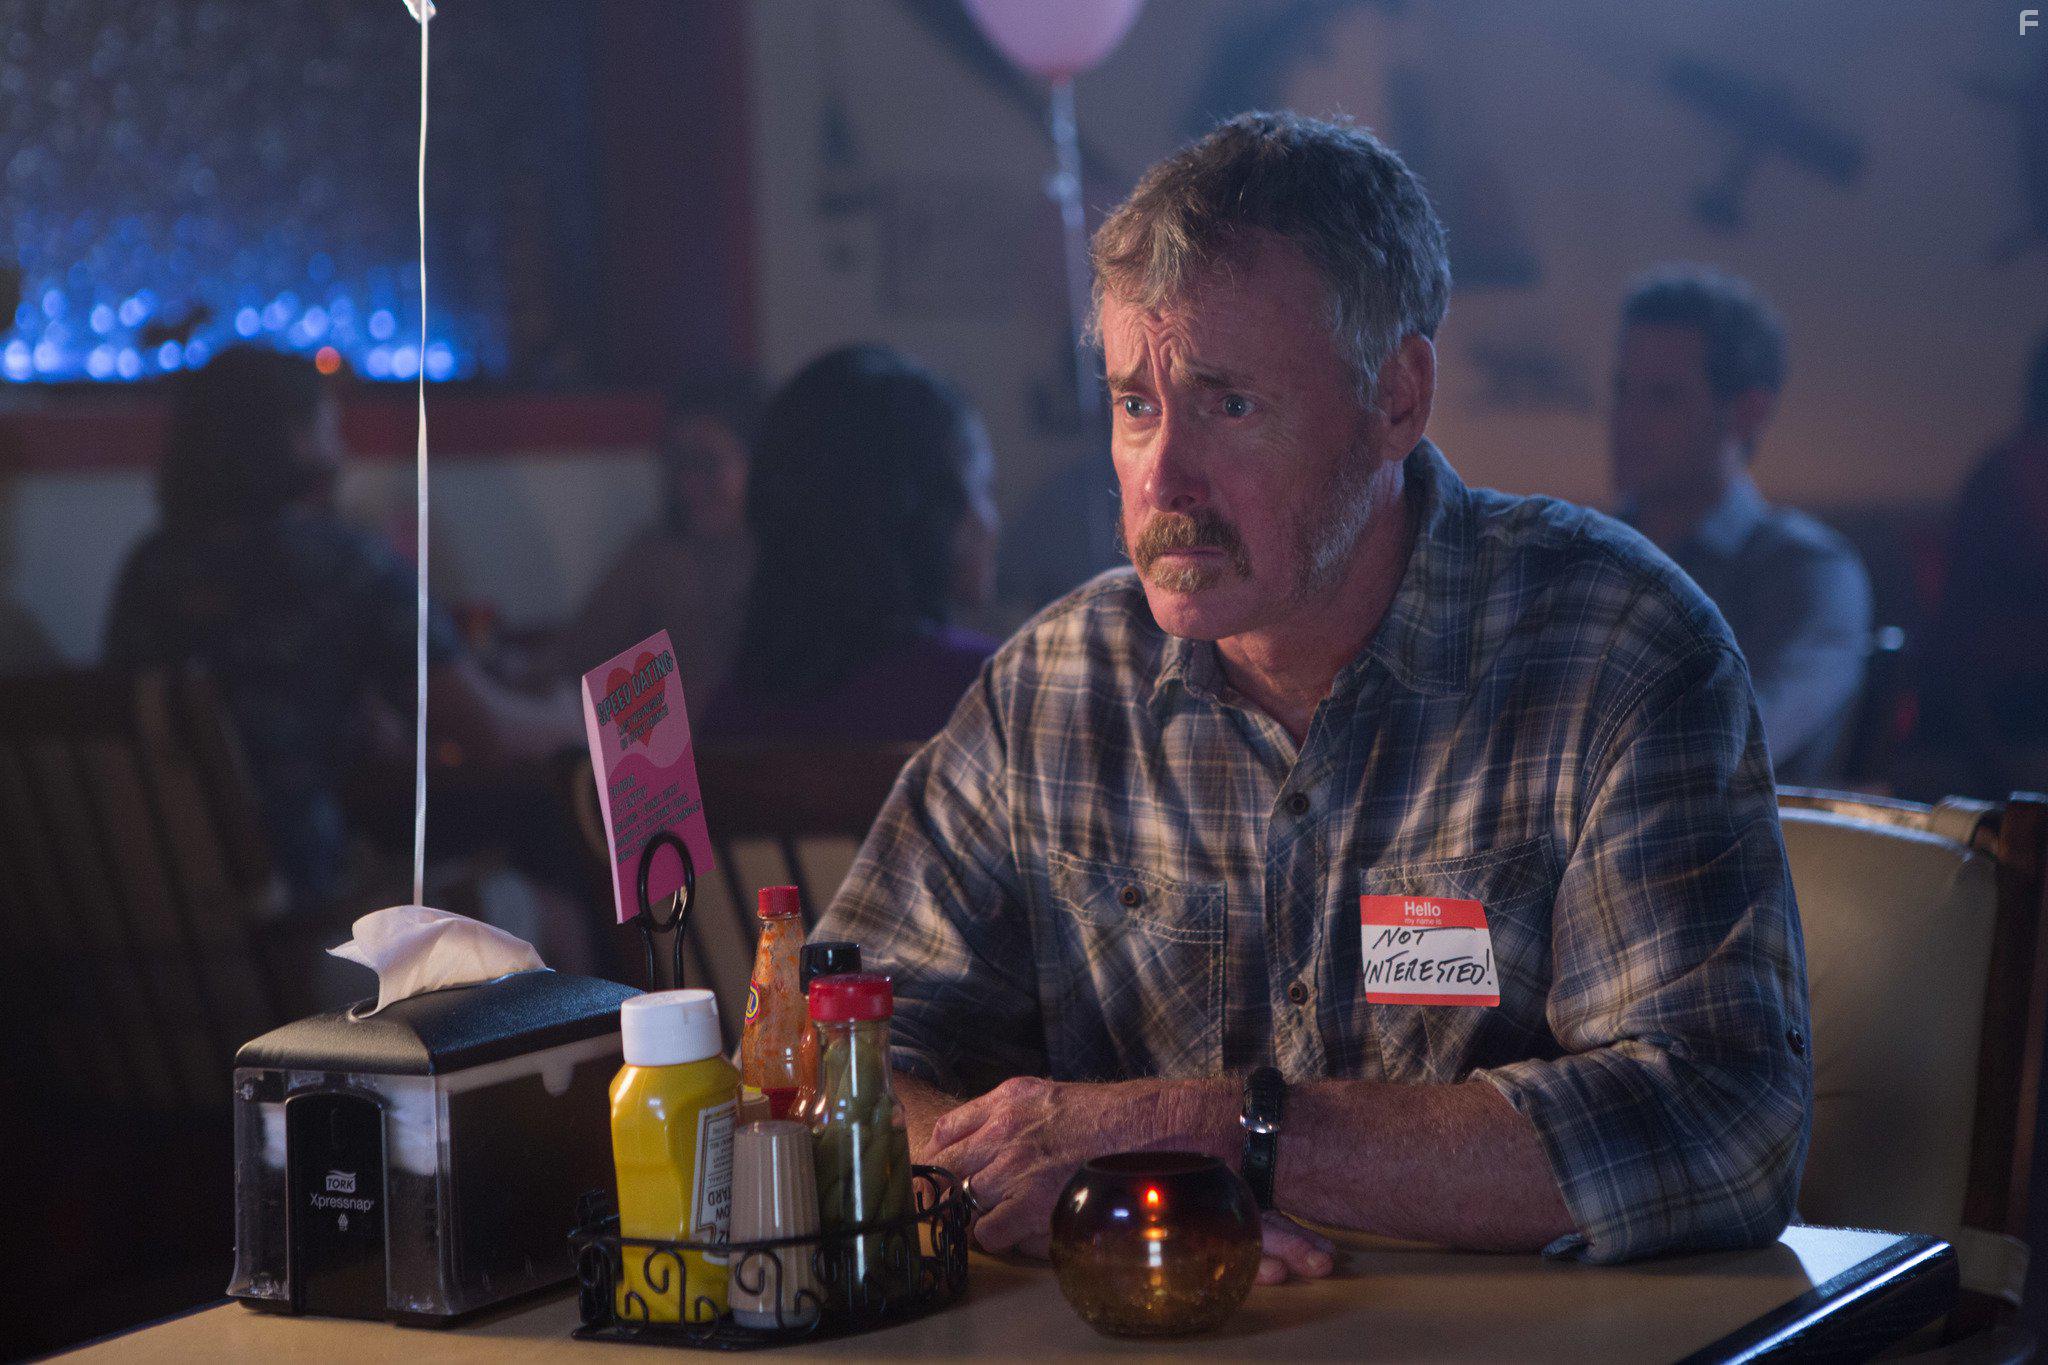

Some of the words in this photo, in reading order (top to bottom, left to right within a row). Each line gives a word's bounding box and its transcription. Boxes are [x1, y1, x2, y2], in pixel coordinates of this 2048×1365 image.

[596, 682, 632, 726] SPEED
[1404, 901, 1442, 917] Hello
[1404, 918, 1415, 926] my
[1372, 926, 1476, 949] NOT
[1363, 948, 1492, 986] INTERESTED!
[328, 1178, 353, 1191] TORK
[310, 1193, 372, 1213] Xpressnap
